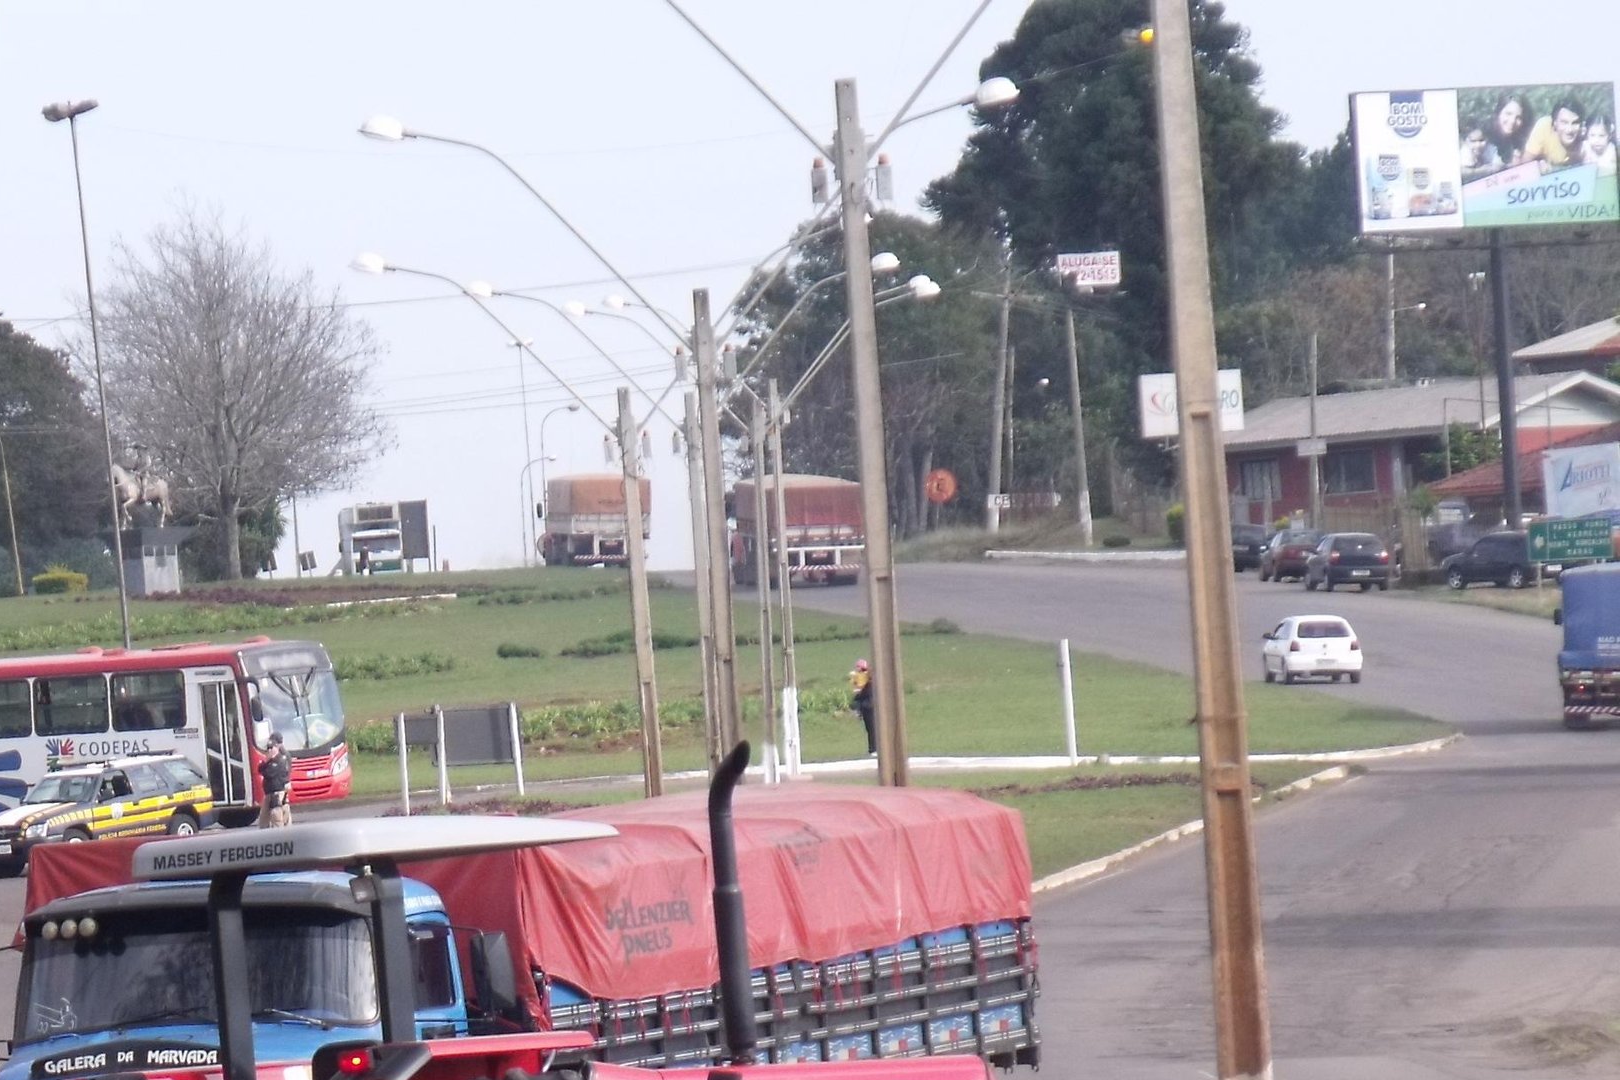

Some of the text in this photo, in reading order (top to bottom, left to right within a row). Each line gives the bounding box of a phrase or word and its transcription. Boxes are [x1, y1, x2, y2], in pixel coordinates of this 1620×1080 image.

[1393, 104, 1420, 115] BOM
[1388, 115, 1428, 126] GOSTO
[1508, 177, 1581, 205] sorriso
[1568, 203, 1616, 218] VIDA!
[79, 739, 150, 757] CODEPAS
[153, 841, 294, 871] MASSEY FERGUSON
[44, 1050, 218, 1074] GALERA DA MARVADA
